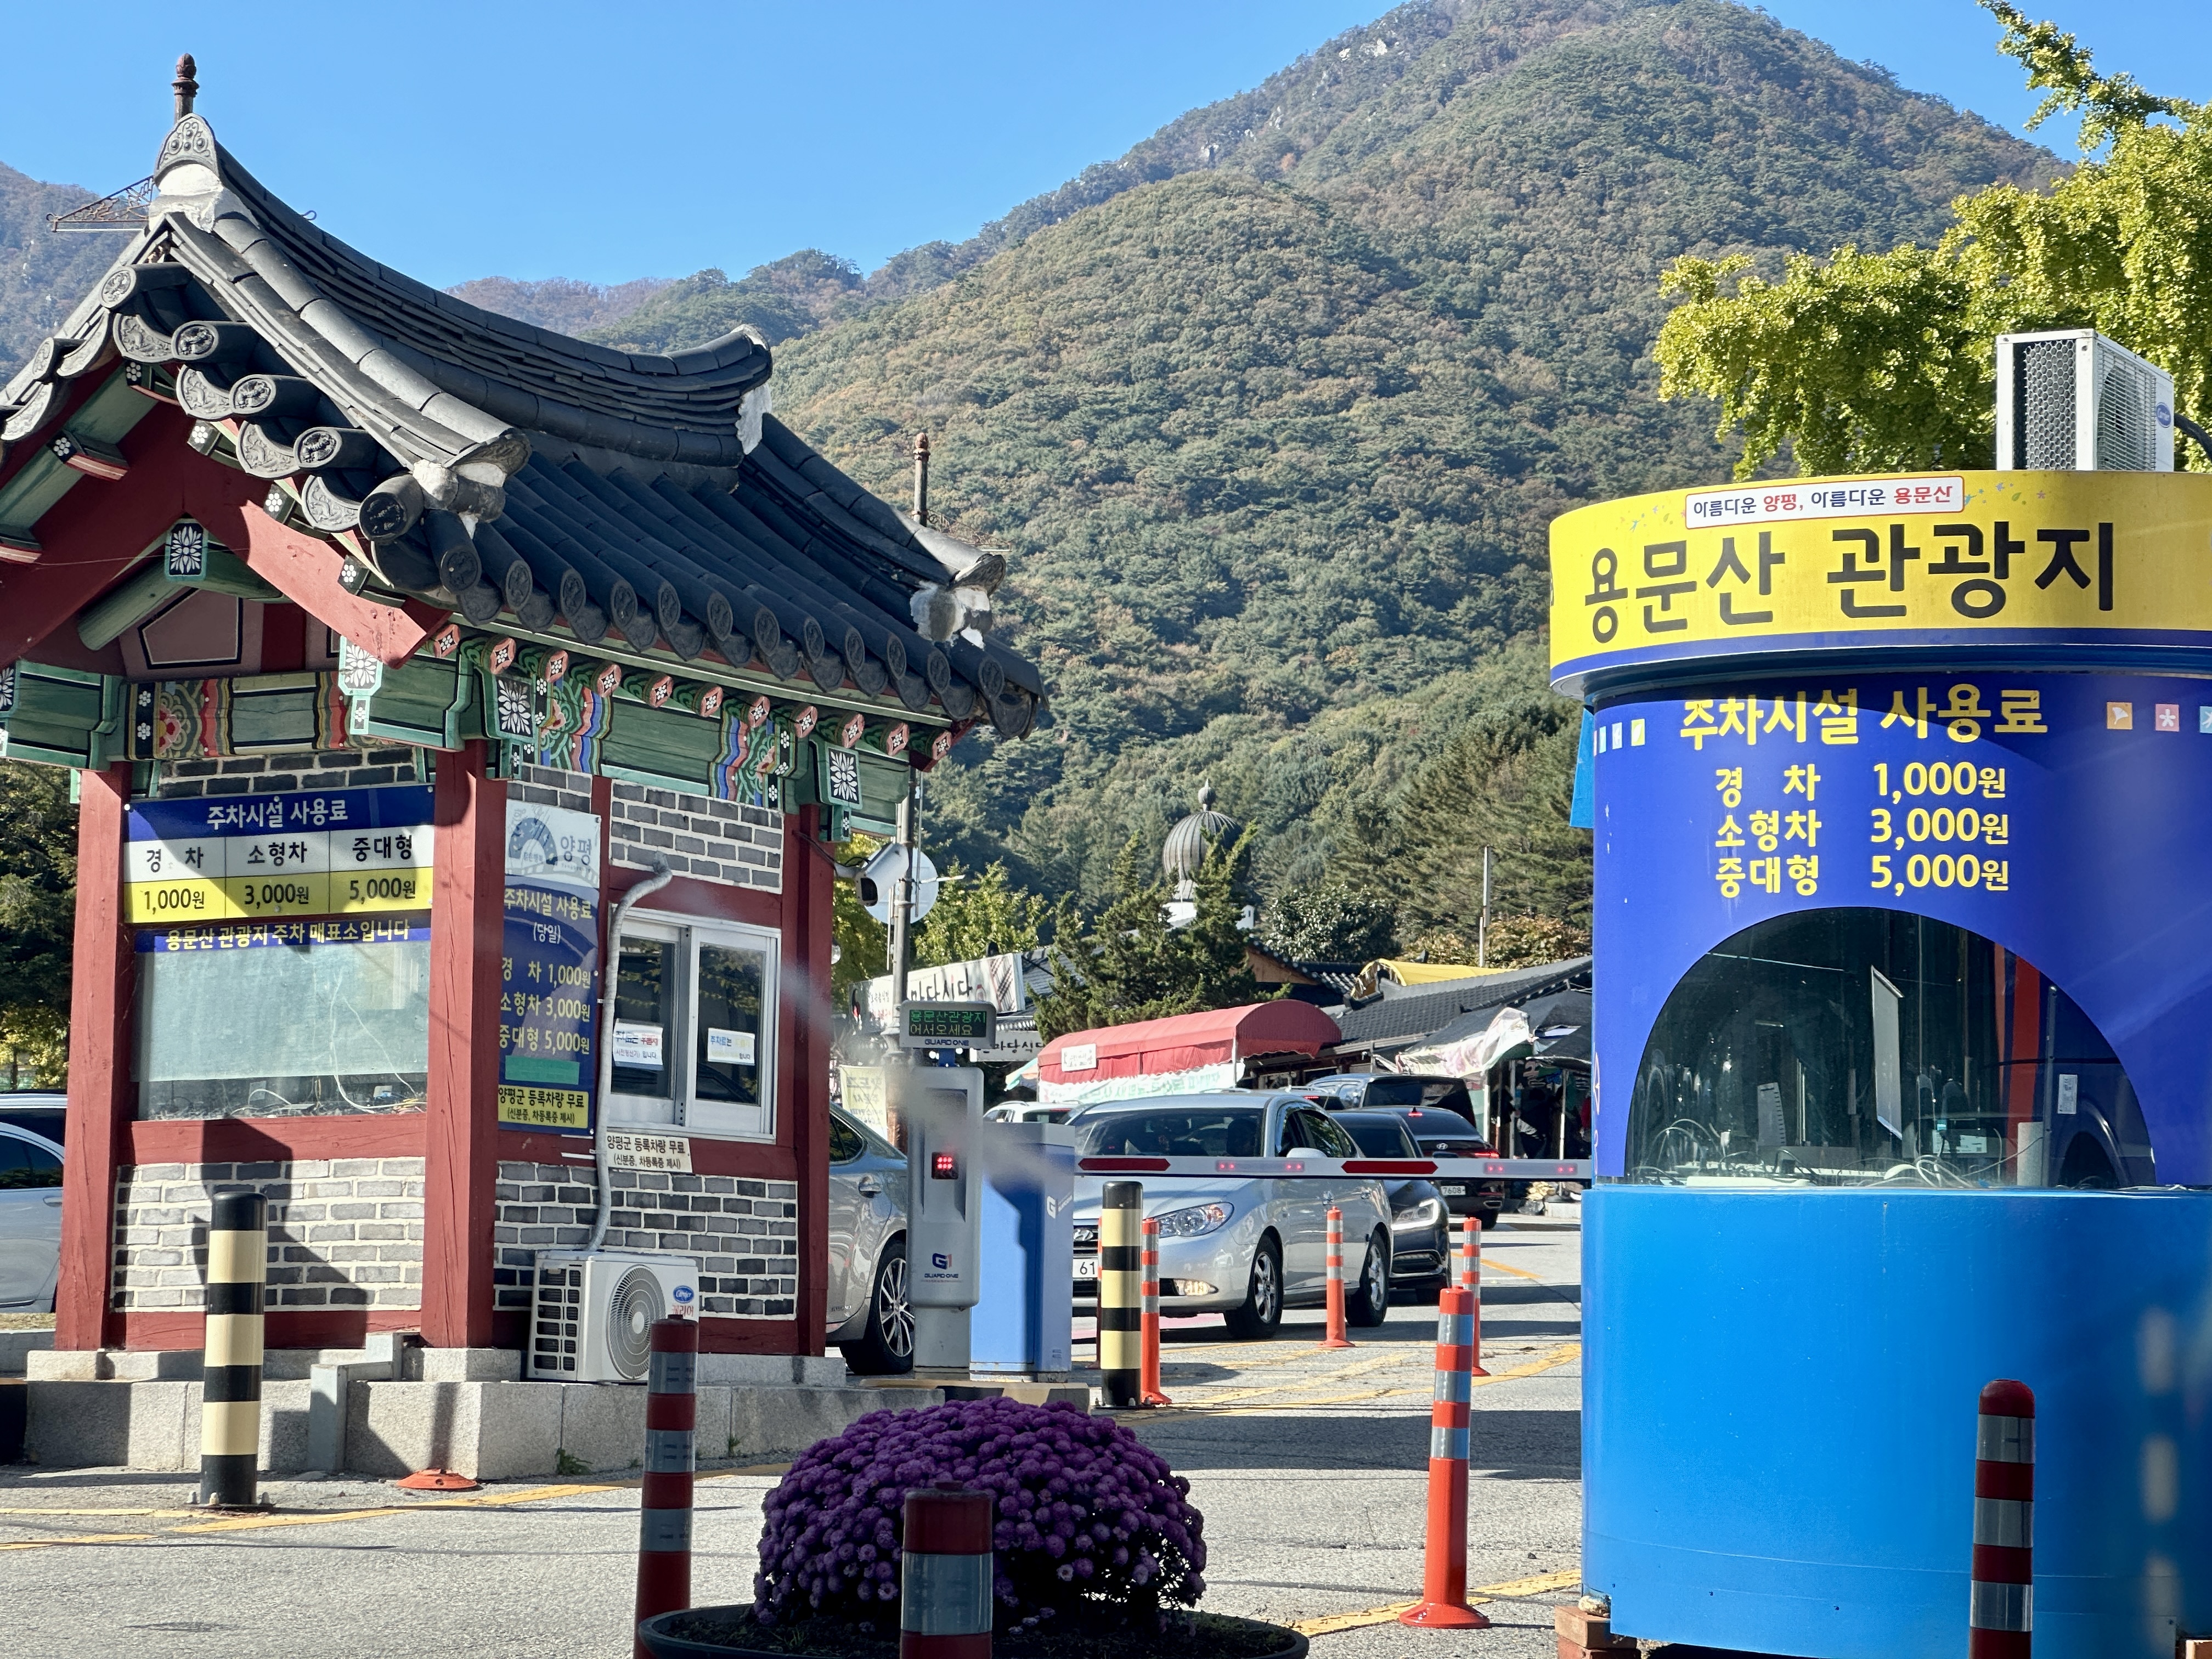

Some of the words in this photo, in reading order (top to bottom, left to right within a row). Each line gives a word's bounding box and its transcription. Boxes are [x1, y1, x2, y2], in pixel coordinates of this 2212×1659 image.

[1693, 496, 1757, 518] 아름다운
[1763, 489, 1805, 514] 양평,
[1810, 488, 1887, 510] 아름다운
[1894, 484, 1954, 506] 용문산
[1584, 529, 1785, 644] 용문산
[1826, 520, 2114, 619] 관광지
[1680, 687, 1860, 751] 주차시설
[1880, 683, 2049, 743] 사용료
[1871, 761, 2007, 803] 1,000원
[207, 800, 284, 830] 주차시설
[290, 798, 348, 826] 사용료
[1714, 809, 1822, 850] 소형차
[1870, 807, 2010, 850] 3,000원
[247, 840, 308, 867] 소형차
[352, 833, 413, 861] 중대형
[560, 835, 592, 865] 양평
[1714, 854, 1820, 898] 중대형
[1870, 853, 2010, 896] 5,000원
[144, 888, 205, 914] 1,000원
[244, 883, 309, 910] 3,000원
[349, 877, 416, 904] 5,000원
[504, 888, 552, 917] 주차시설
[556, 896, 593, 920] 사용료
[166, 927, 214, 951] 용문산
[218, 924, 269, 947] 관광지
[272, 922, 306, 944] 주차
[309, 919, 410, 941] 매표소입니다
[533, 921, 561, 944] (당일)
[548, 963, 591, 989] 1,000원
[500, 991, 541, 1017] 소형차
[546, 996, 591, 1023] 3,000원
[911, 1010, 986, 1024] 용문산관광지
[499, 1024, 539, 1052] 중대형
[545, 1030, 590, 1055] 5,000원
[910, 1024, 973, 1036] 어서오세요
[498, 1087, 526, 1105] 양평군
[528, 1090, 564, 1108] 등록차량
[566, 1093, 585, 1109] 무료
[607, 1135, 631, 1151] 양평군
[634, 1137, 666, 1153] 등록차량
[669, 1141, 686, 1154] 무료
